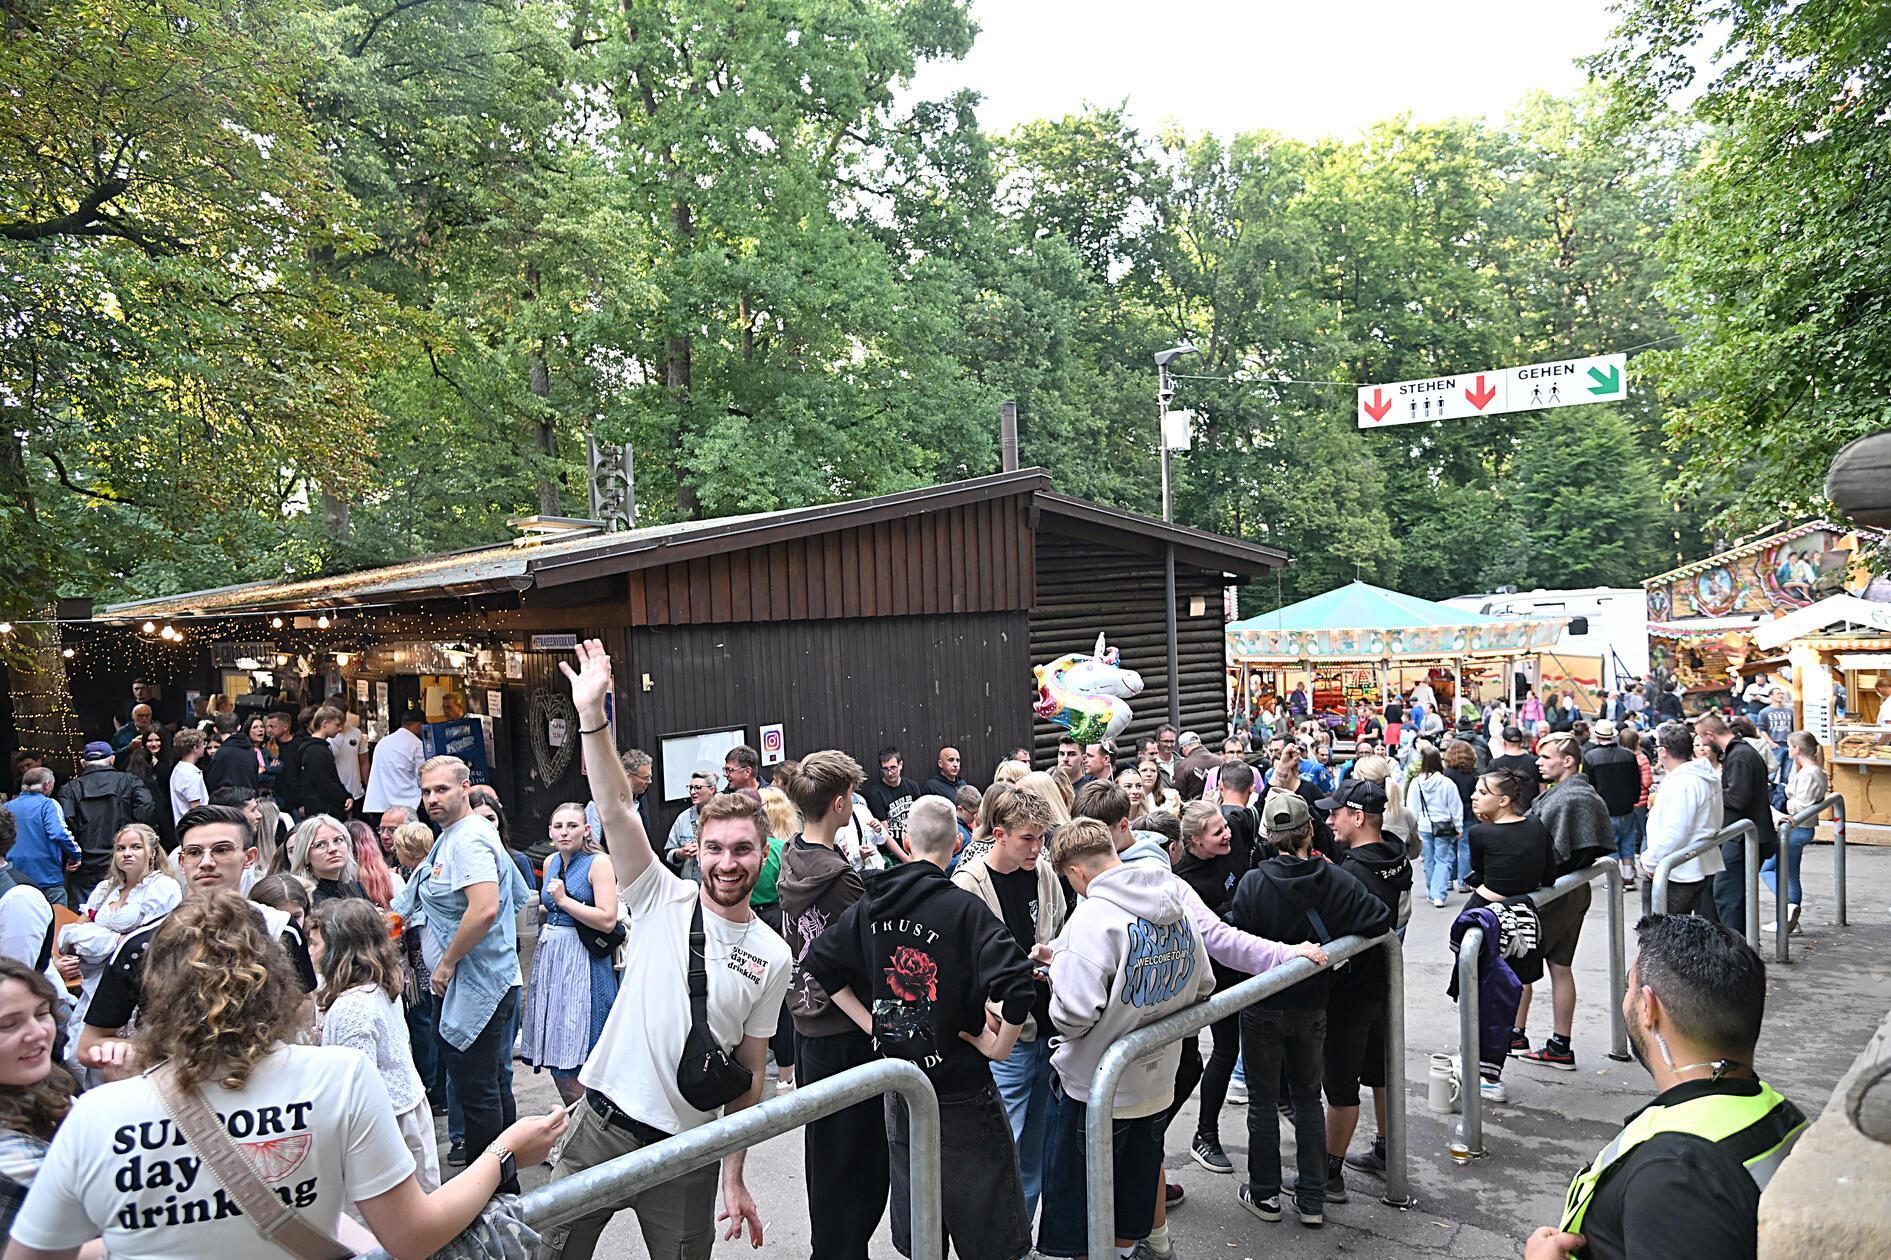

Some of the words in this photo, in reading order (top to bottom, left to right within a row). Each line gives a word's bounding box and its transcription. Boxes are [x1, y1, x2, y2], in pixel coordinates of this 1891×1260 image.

[1518, 363, 1575, 380] GEHEN
[1399, 378, 1456, 395] STEHEN
[1346, 800, 1363, 810] uvex
[870, 919, 939, 945] TRUST
[1127, 914, 1197, 968] DREAM
[730, 953, 748, 967] day
[732, 946, 769, 968] SUPPORT
[1137, 954, 1174, 969] WELCOME
[727, 962, 761, 985] drinking
[1121, 956, 1197, 1009] WORLD
[115, 1155, 201, 1193] day
[118, 1176, 318, 1230] drinkng
